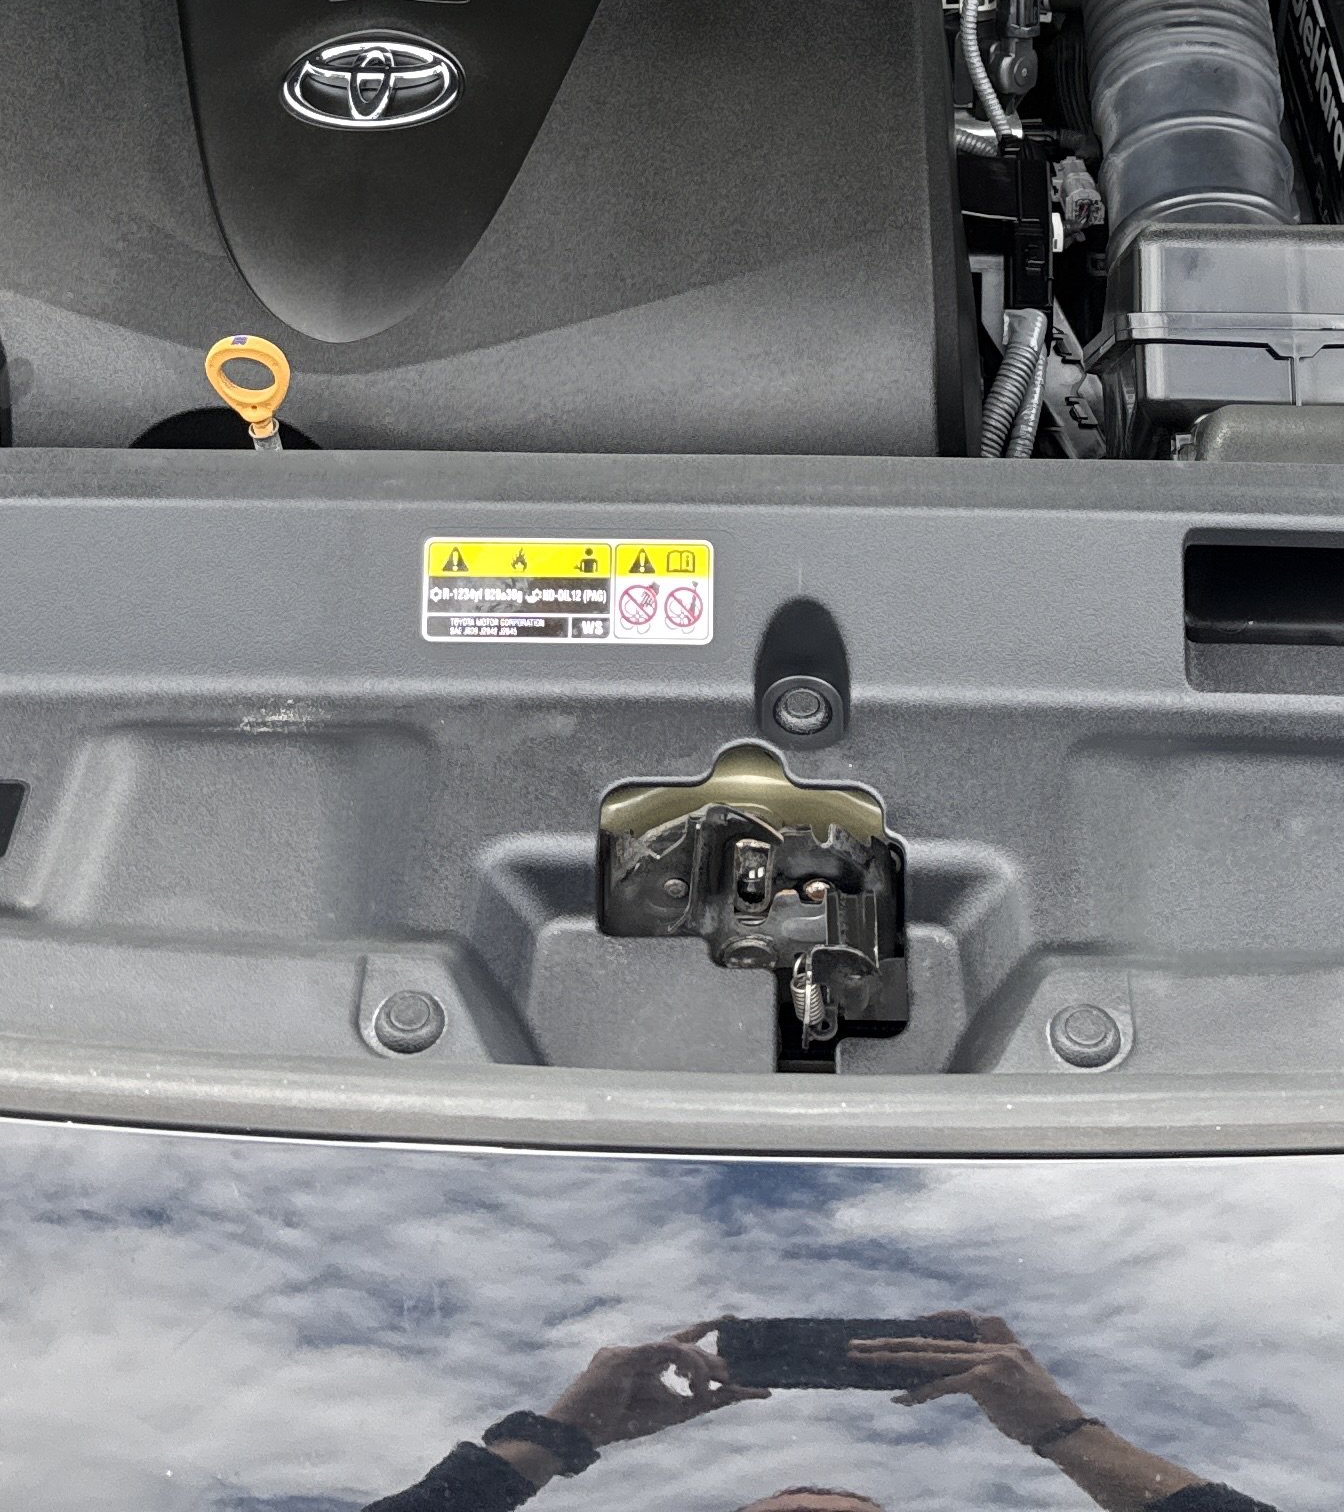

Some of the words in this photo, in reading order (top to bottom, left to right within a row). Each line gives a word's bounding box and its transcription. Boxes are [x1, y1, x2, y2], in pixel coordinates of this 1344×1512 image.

[583, 589, 607, 604] (PAG)
[450, 617, 475, 626] TOYOTA
[476, 618, 499, 626] MOTOR
[500, 618, 545, 627] CORPORATION
[581, 621, 603, 635] WS
